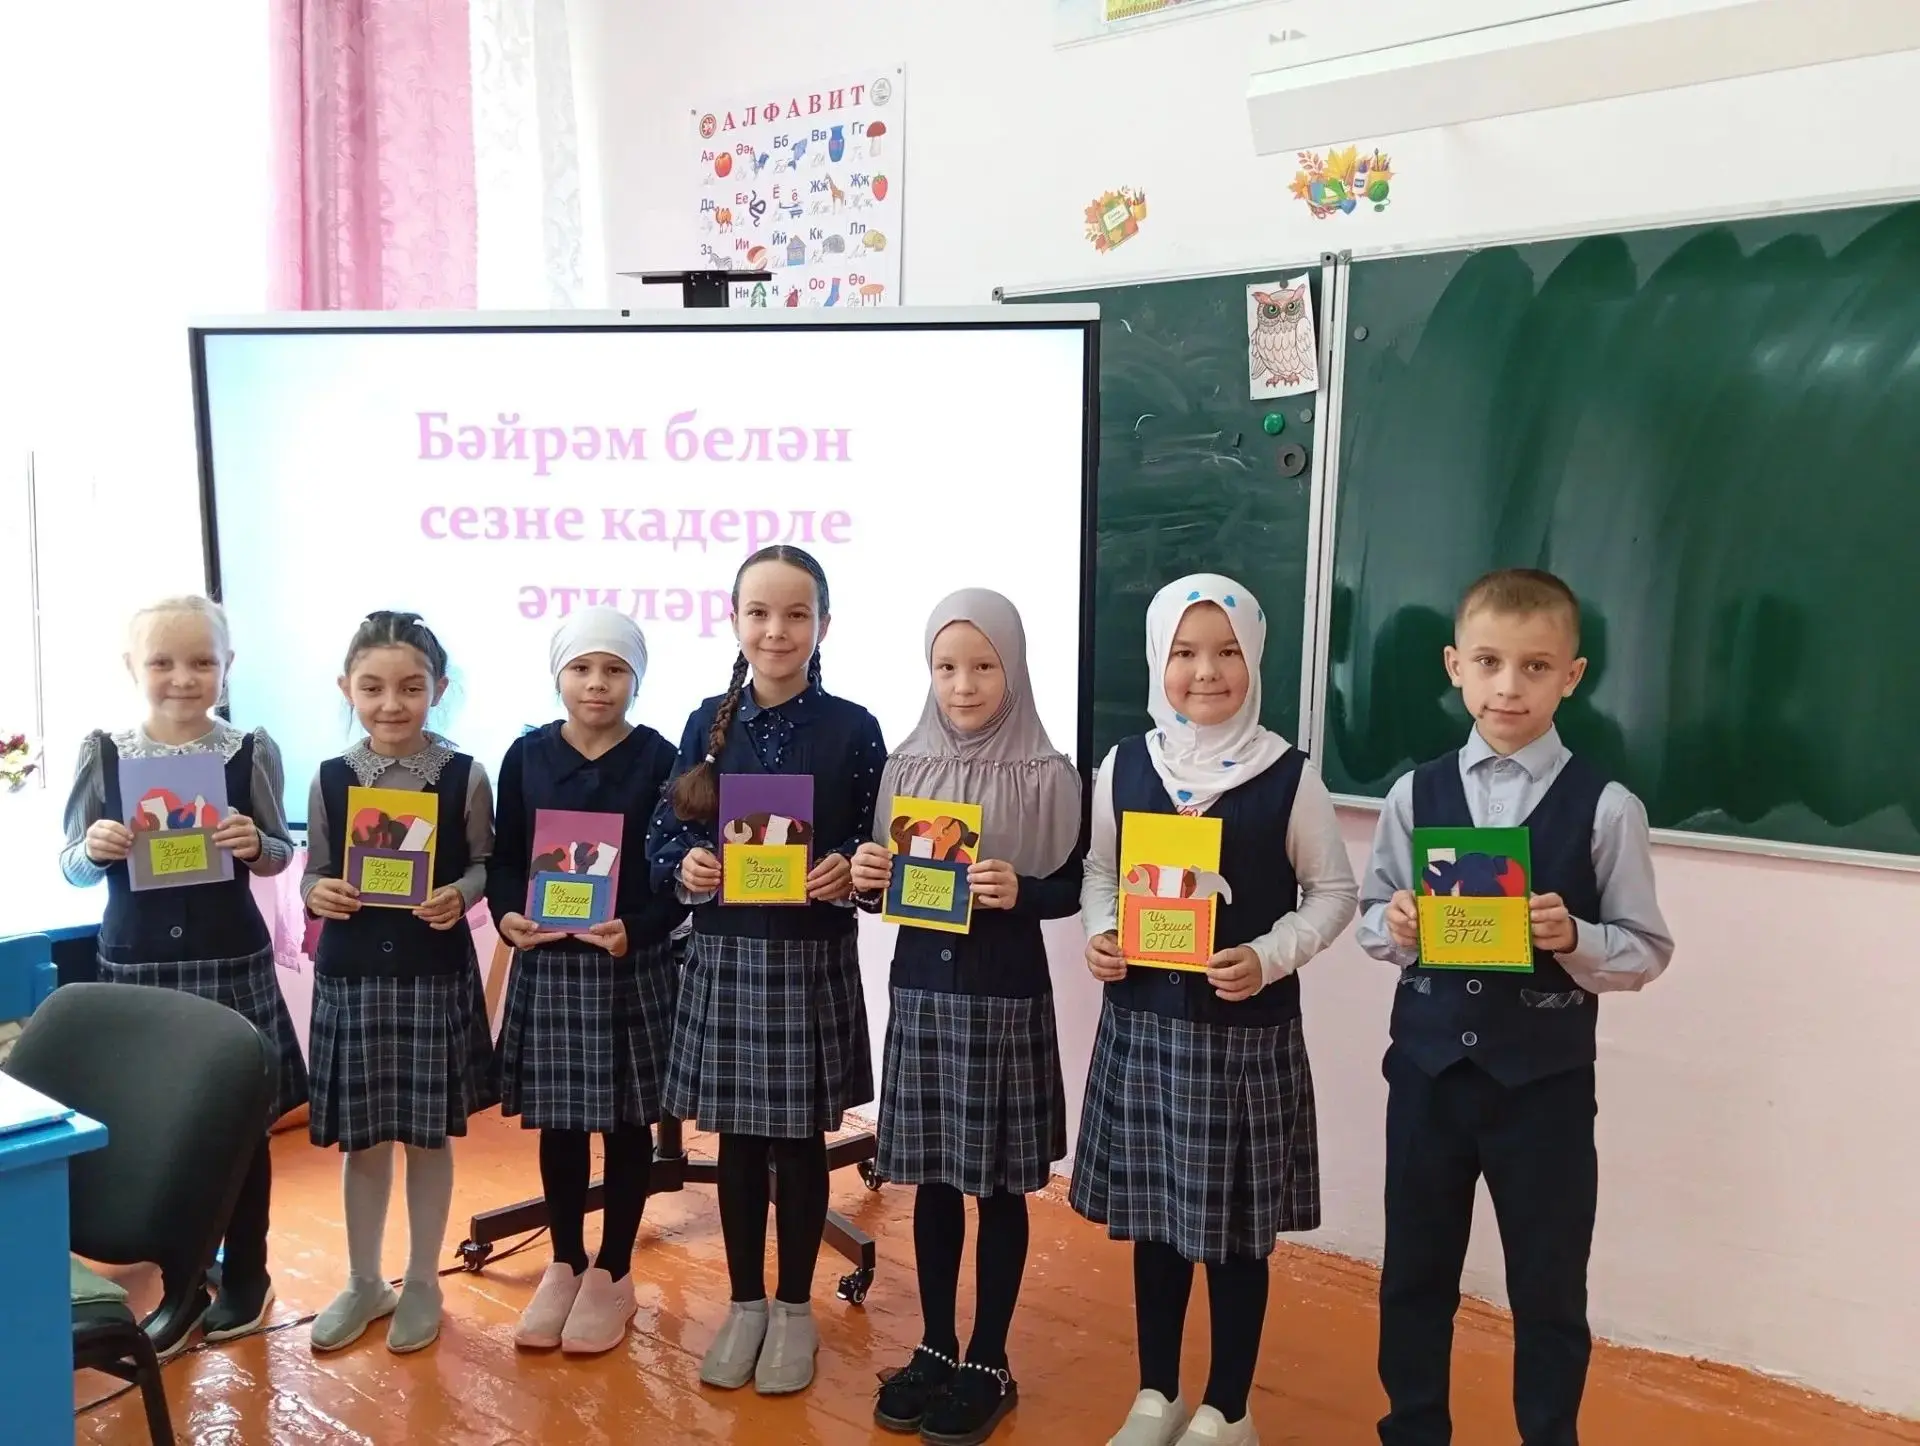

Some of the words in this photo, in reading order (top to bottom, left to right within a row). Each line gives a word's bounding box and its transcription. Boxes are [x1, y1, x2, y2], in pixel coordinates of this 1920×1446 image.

[721, 85, 865, 131] АЛФАВИТ
[773, 134, 789, 149] Бб
[811, 129, 827, 142] Вв
[851, 122, 864, 135] Гг
[735, 193, 749, 205] Ее
[810, 180, 828, 193] Жж
[735, 238, 750, 251] Ии
[809, 227, 823, 241] Кк
[849, 222, 866, 236] Лл
[735, 285, 749, 299] Нн
[808, 277, 825, 291] Оо
[415, 412, 648, 476] Бәйрәм
[664, 408, 853, 462] белән
[420, 505, 584, 540] сезне
[601, 507, 852, 556] кадерле
[906, 890, 943, 906] ӘТИ
[1145, 932, 1187, 949] ӘТИ
[1444, 928, 1492, 944] ӘТИ
